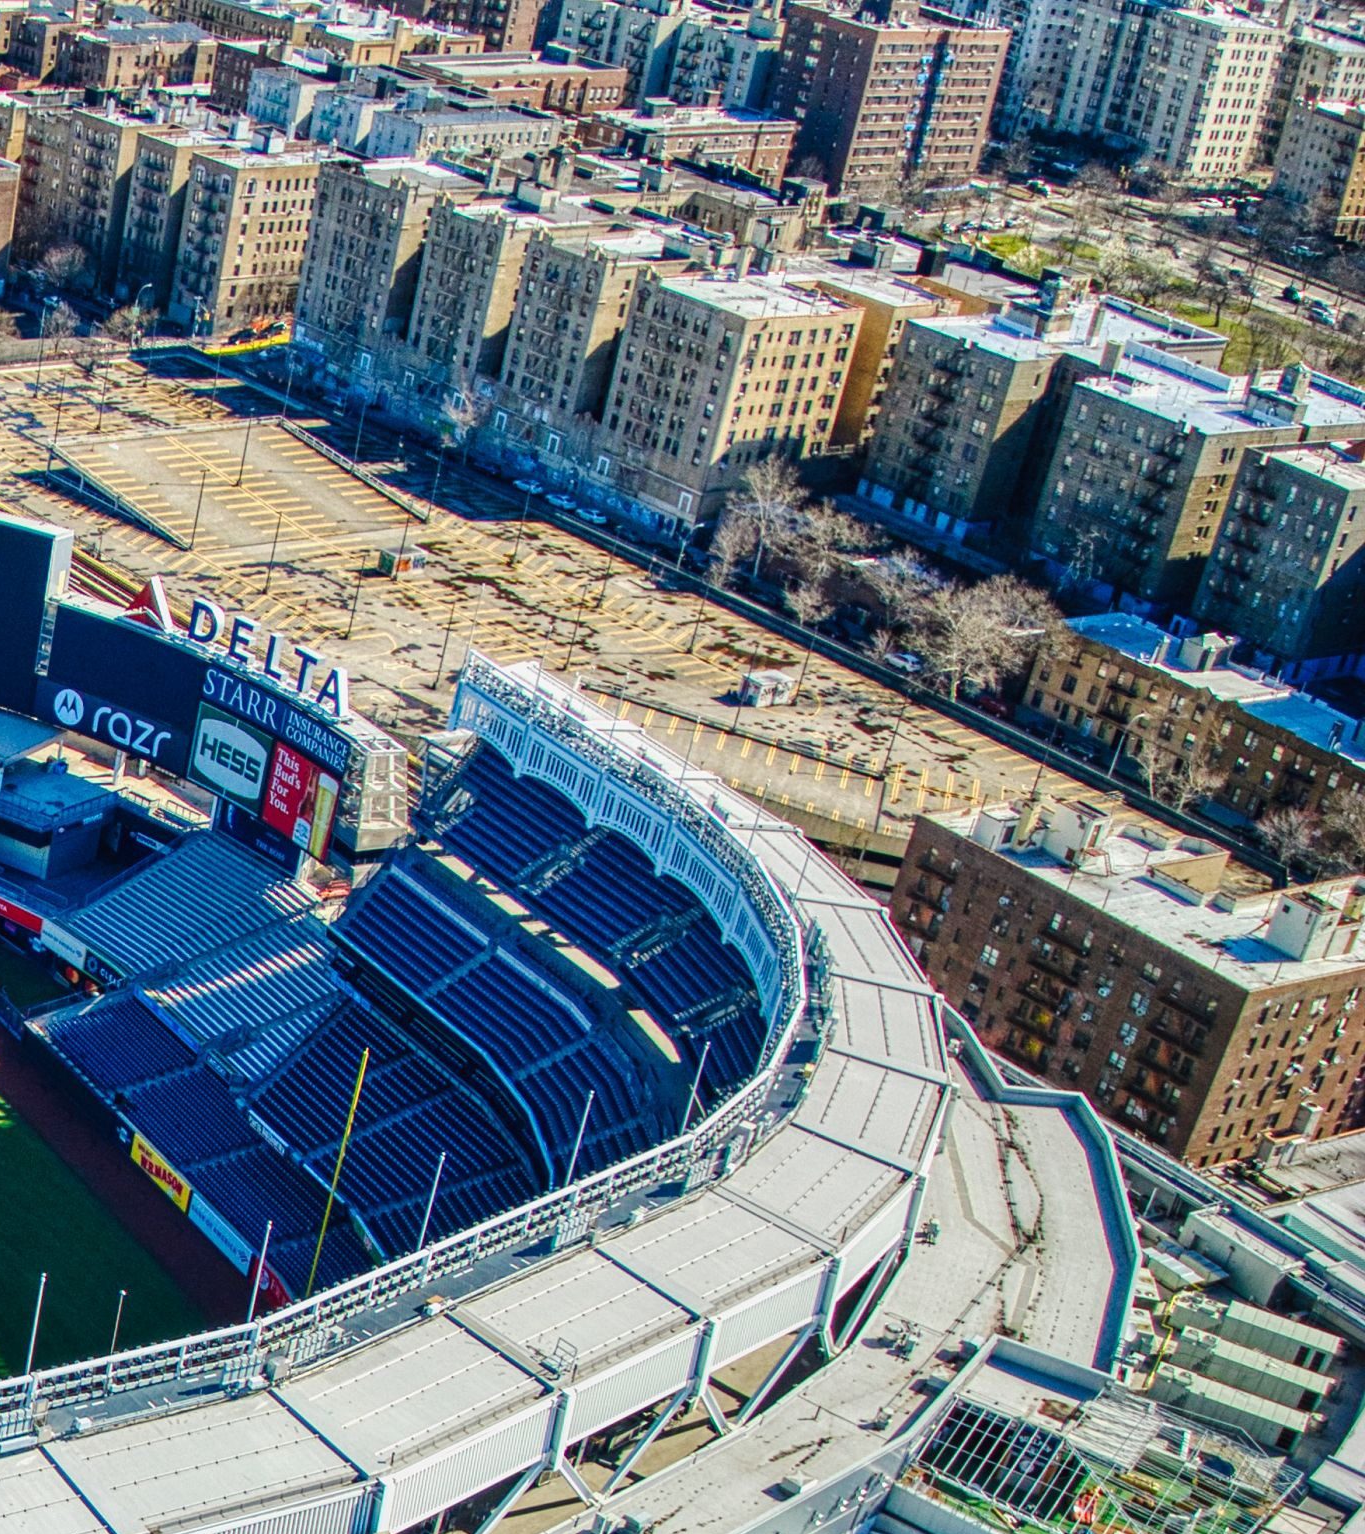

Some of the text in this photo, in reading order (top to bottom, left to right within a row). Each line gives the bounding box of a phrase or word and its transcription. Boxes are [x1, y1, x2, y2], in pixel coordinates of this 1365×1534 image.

[188, 597, 349, 717] DELTA
[203, 669, 279, 731] STARR
[91, 706, 172, 757] razr
[285, 724, 347, 772] COMPANIES
[288, 709, 348, 757] INSURANCE
[200, 733, 262, 784] HESS
[274, 764, 301, 791] Bud's
[277, 749, 300, 772] This
[268, 791, 290, 815] You.
[271, 778, 289, 798] For
